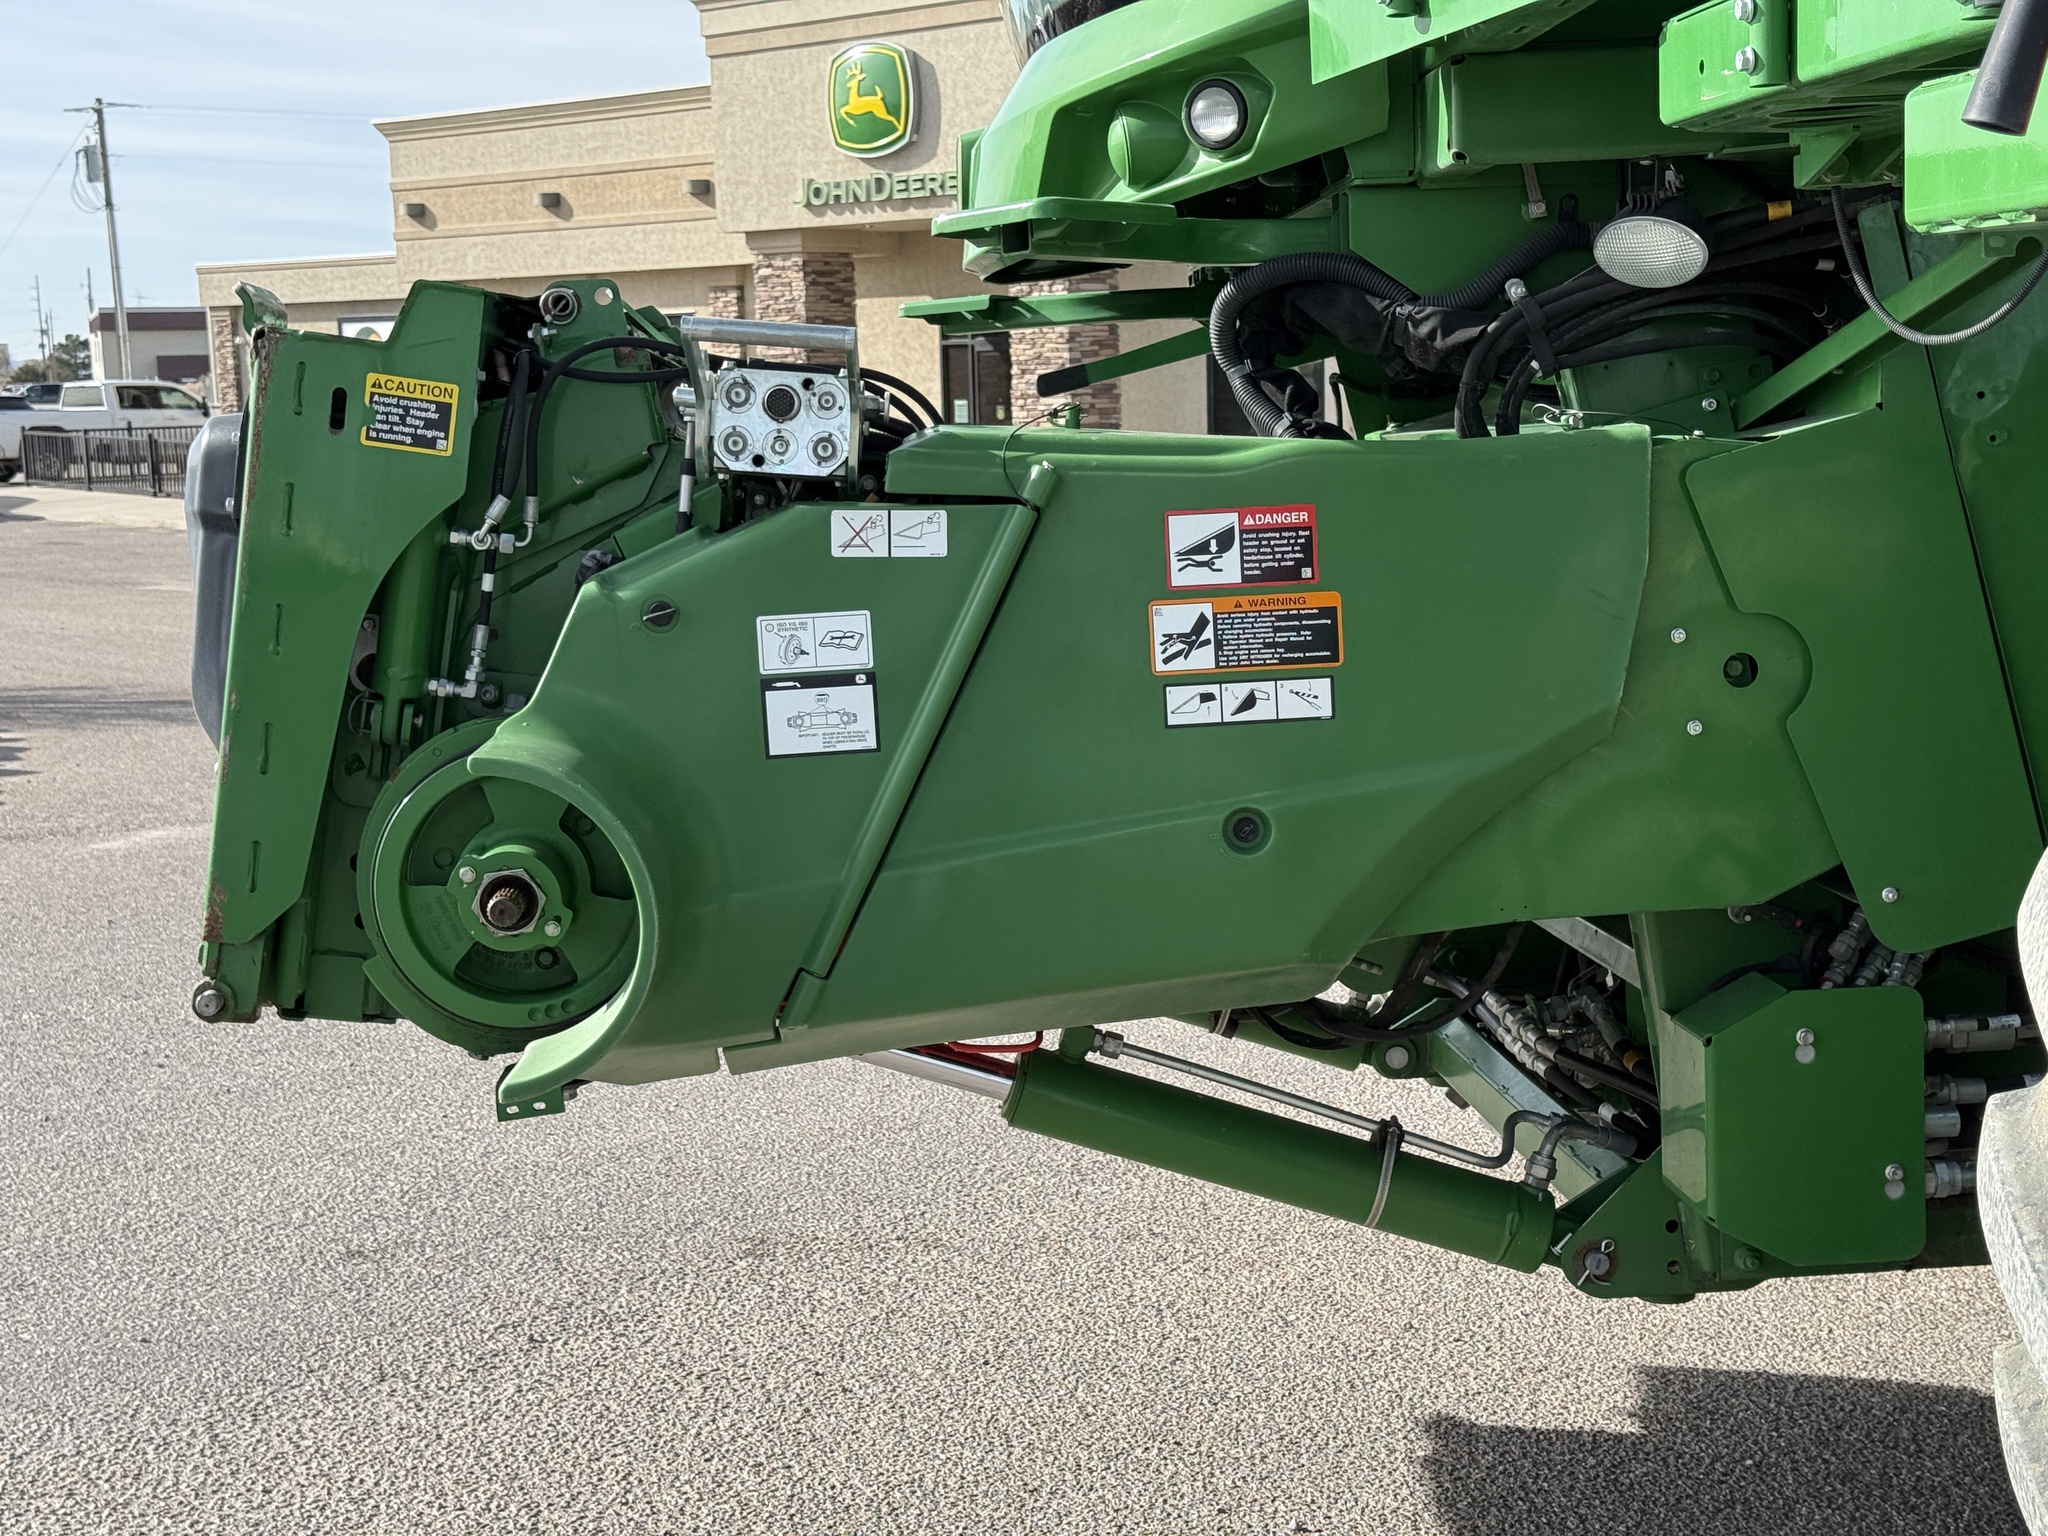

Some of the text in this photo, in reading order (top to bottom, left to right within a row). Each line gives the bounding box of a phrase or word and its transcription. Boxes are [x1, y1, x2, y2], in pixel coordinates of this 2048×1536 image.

[794, 171, 957, 207] JOHN DEERE
[384, 379, 454, 399] CAUTION
[373, 394, 436, 411] Avoid crushing
[388, 415, 402, 423] tilt.
[406, 417, 425, 427] Stay
[410, 408, 440, 420] Header
[369, 430, 413, 444] is running.
[393, 425, 415, 434] when
[416, 428, 445, 438] engine
[1255, 511, 1309, 525] DANGER
[1248, 596, 1306, 607] WARNING
